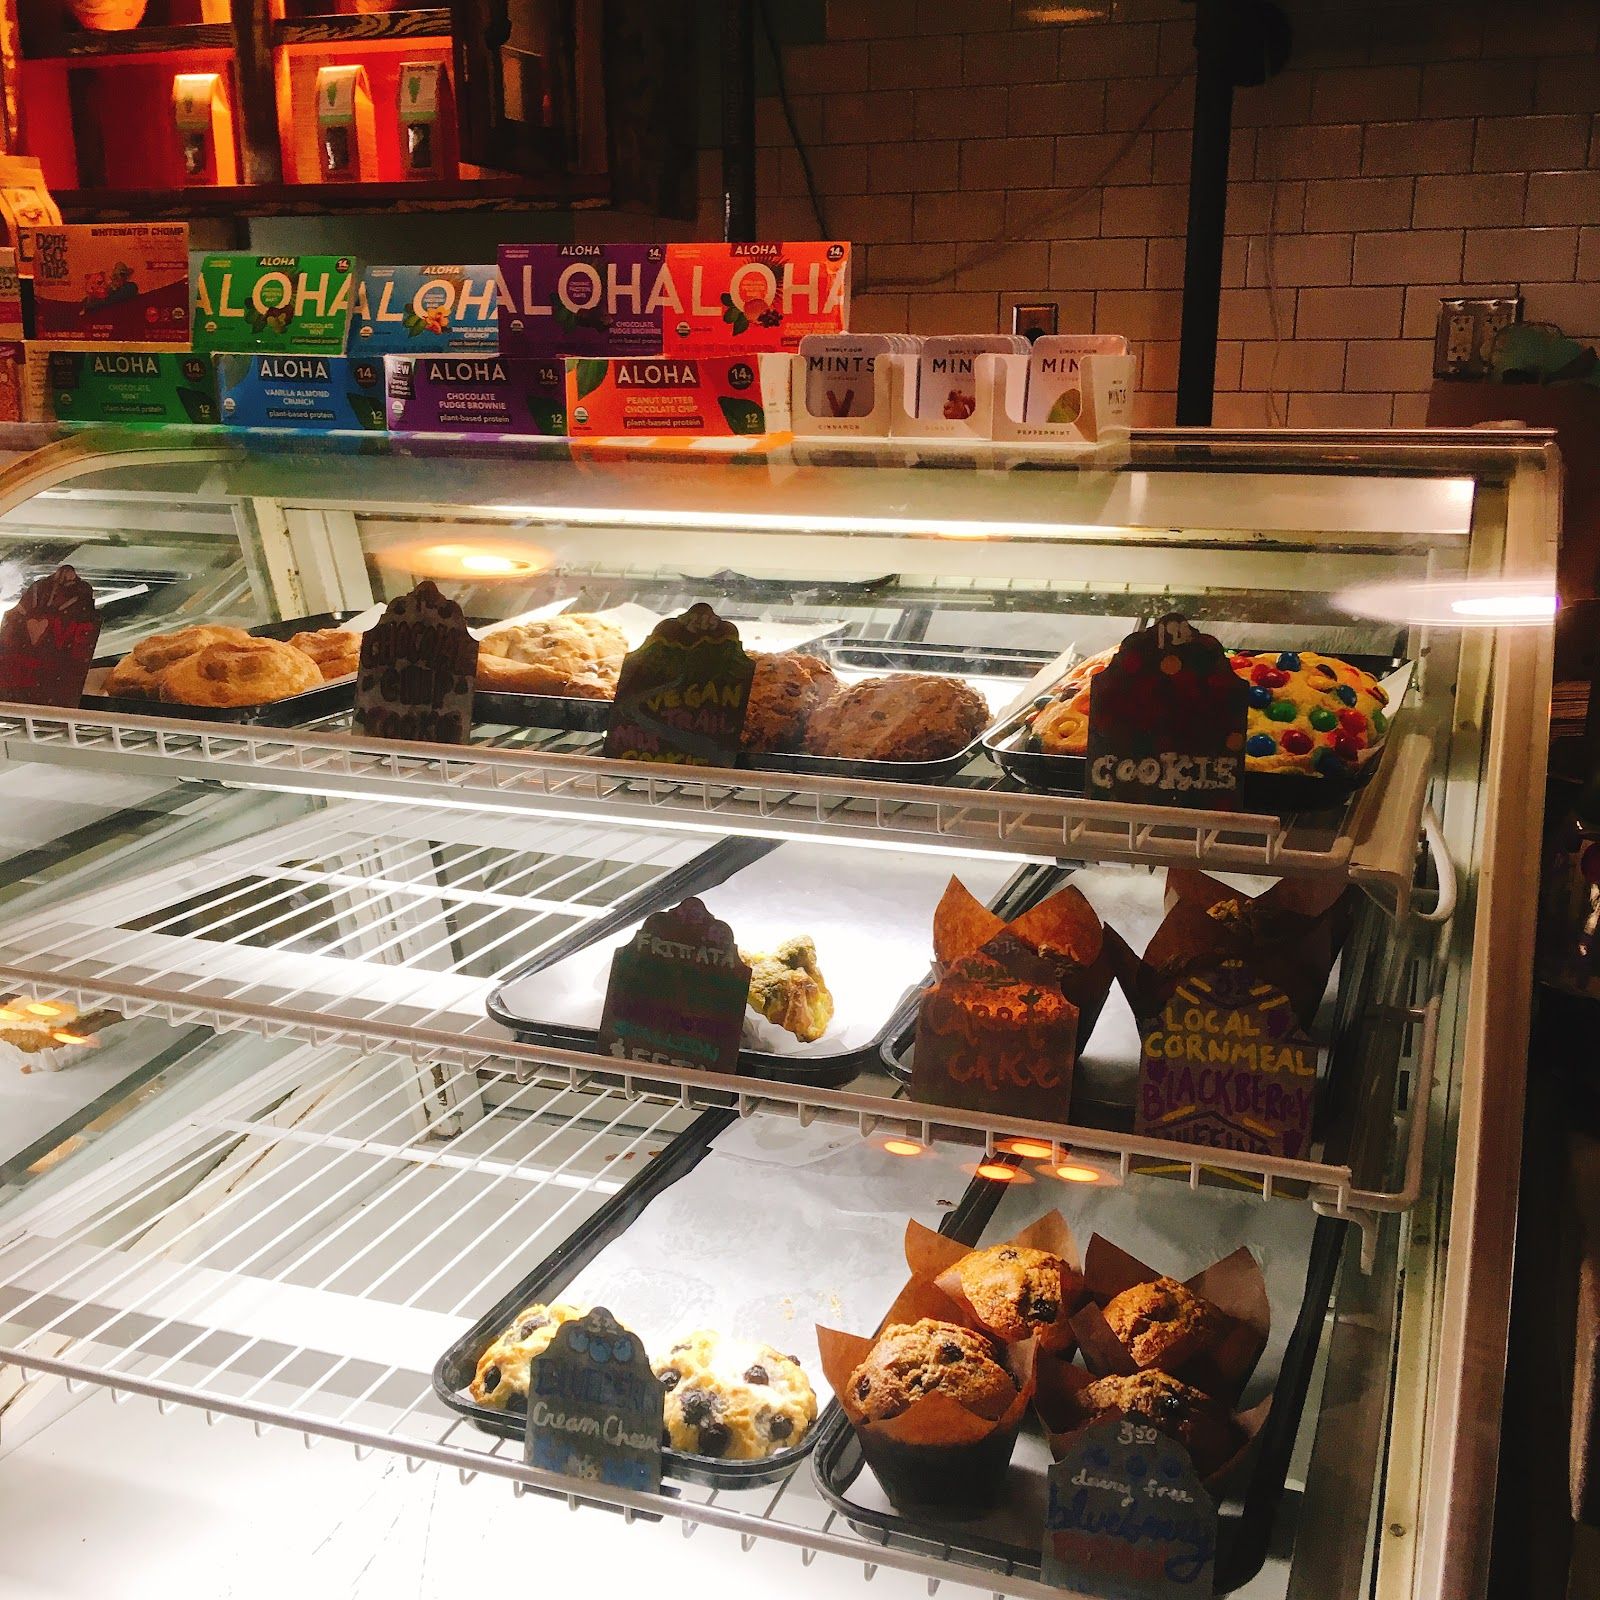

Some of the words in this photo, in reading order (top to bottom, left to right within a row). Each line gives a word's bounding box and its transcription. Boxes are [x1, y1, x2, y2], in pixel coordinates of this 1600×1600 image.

[91, 227, 149, 237] WHITEWATER
[151, 227, 184, 236] CHOMP
[560, 245, 601, 256] ALOHA
[734, 245, 778, 256] ALOHA
[260, 257, 296, 266] ALOHA
[422, 265, 460, 275] ALOHA
[94, 356, 160, 374] ALOHA
[260, 359, 329, 379] ALOHA
[808, 356, 876, 373] MINTS
[932, 358, 973, 374] MIN
[1041, 358, 1080, 373] MIN
[429, 362, 507, 382] ALOHA
[617, 364, 698, 384] ALOHA
[264, 388, 295, 398] VANILLA
[296, 389, 330, 398] ALMOND
[446, 392, 496, 401] CHOCOLATE
[282, 397, 314, 406] CRUNCH
[438, 400, 466, 409] FUDGE
[467, 401, 507, 410] BROWNIE
[626, 396, 661, 405] PEANUT
[661, 396, 694, 405] BUTTER
[199, 403, 211, 414] 12
[624, 404, 676, 414] CHOCOLATE
[677, 405, 699, 414] CHIP
[268, 410, 309, 420] plant-based
[309, 411, 334, 422] protein
[371, 410, 384, 421] 12
[439, 414, 483, 424] plant-based
[483, 415, 510, 424] protein
[551, 413, 563, 424] 12
[745, 413, 759, 424] 12
[626, 418, 671, 429] plant-based
[672, 417, 702, 427] protein
[646, 680, 743, 713] VEGAN
[1165, 1005, 1262, 1039] LOCAL
[1143, 1029, 1316, 1077] CORNMEAL
[532, 1400, 601, 1438] Cream
